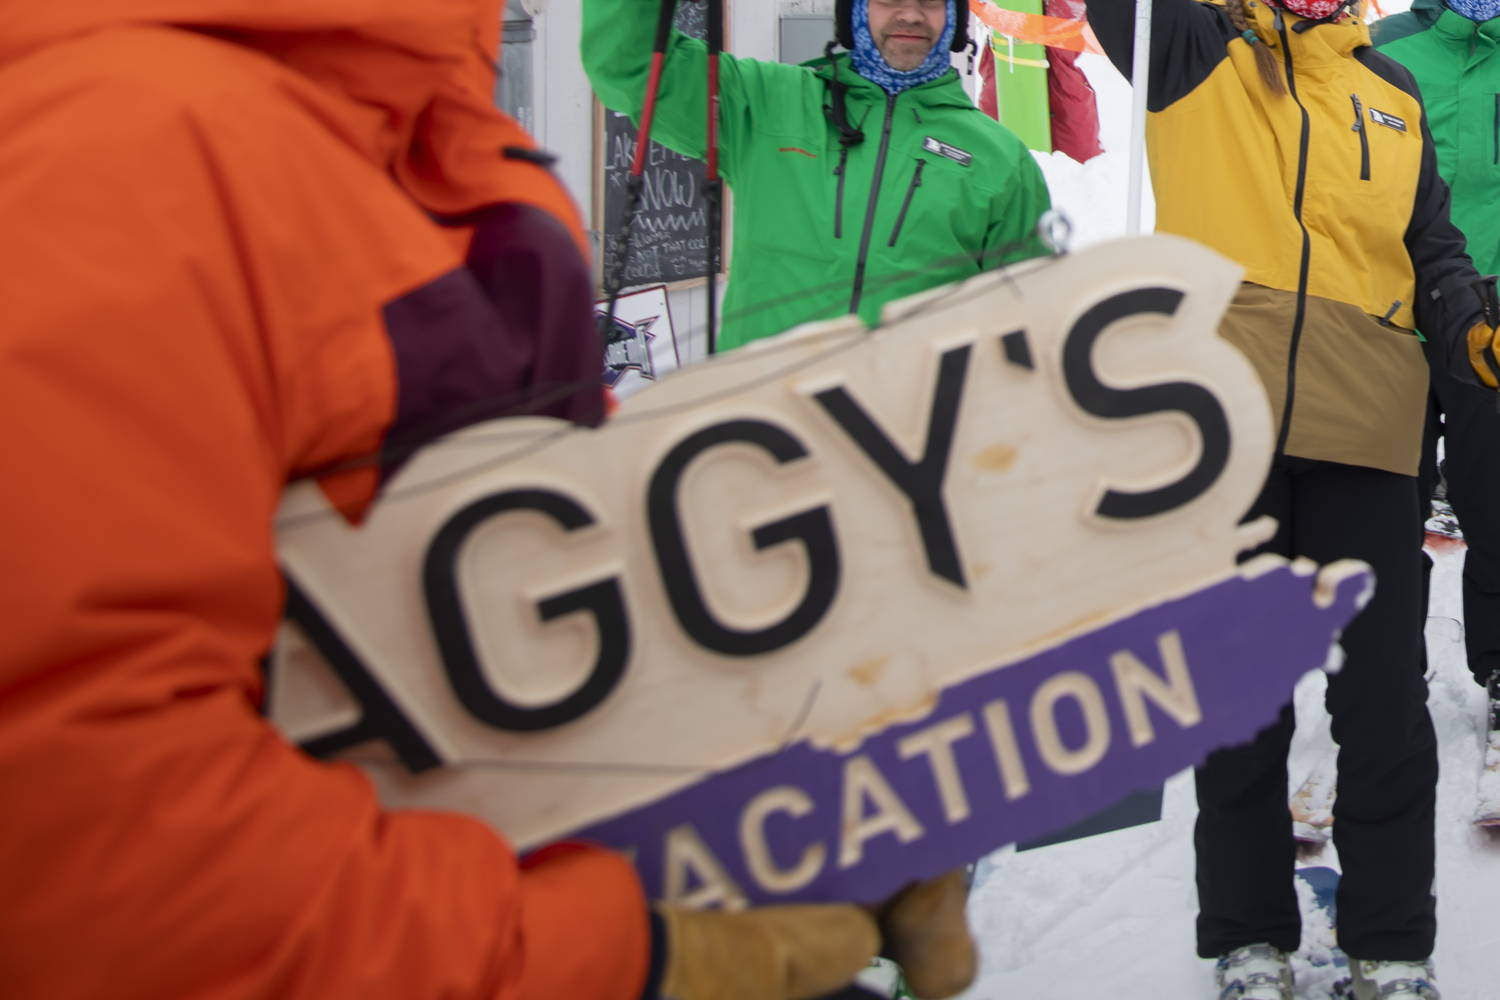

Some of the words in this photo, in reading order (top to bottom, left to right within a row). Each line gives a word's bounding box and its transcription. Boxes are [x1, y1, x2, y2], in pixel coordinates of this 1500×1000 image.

[625, 167, 695, 211] NOW
[262, 284, 1232, 775] AGGY'S
[628, 629, 1203, 911] ACATION
